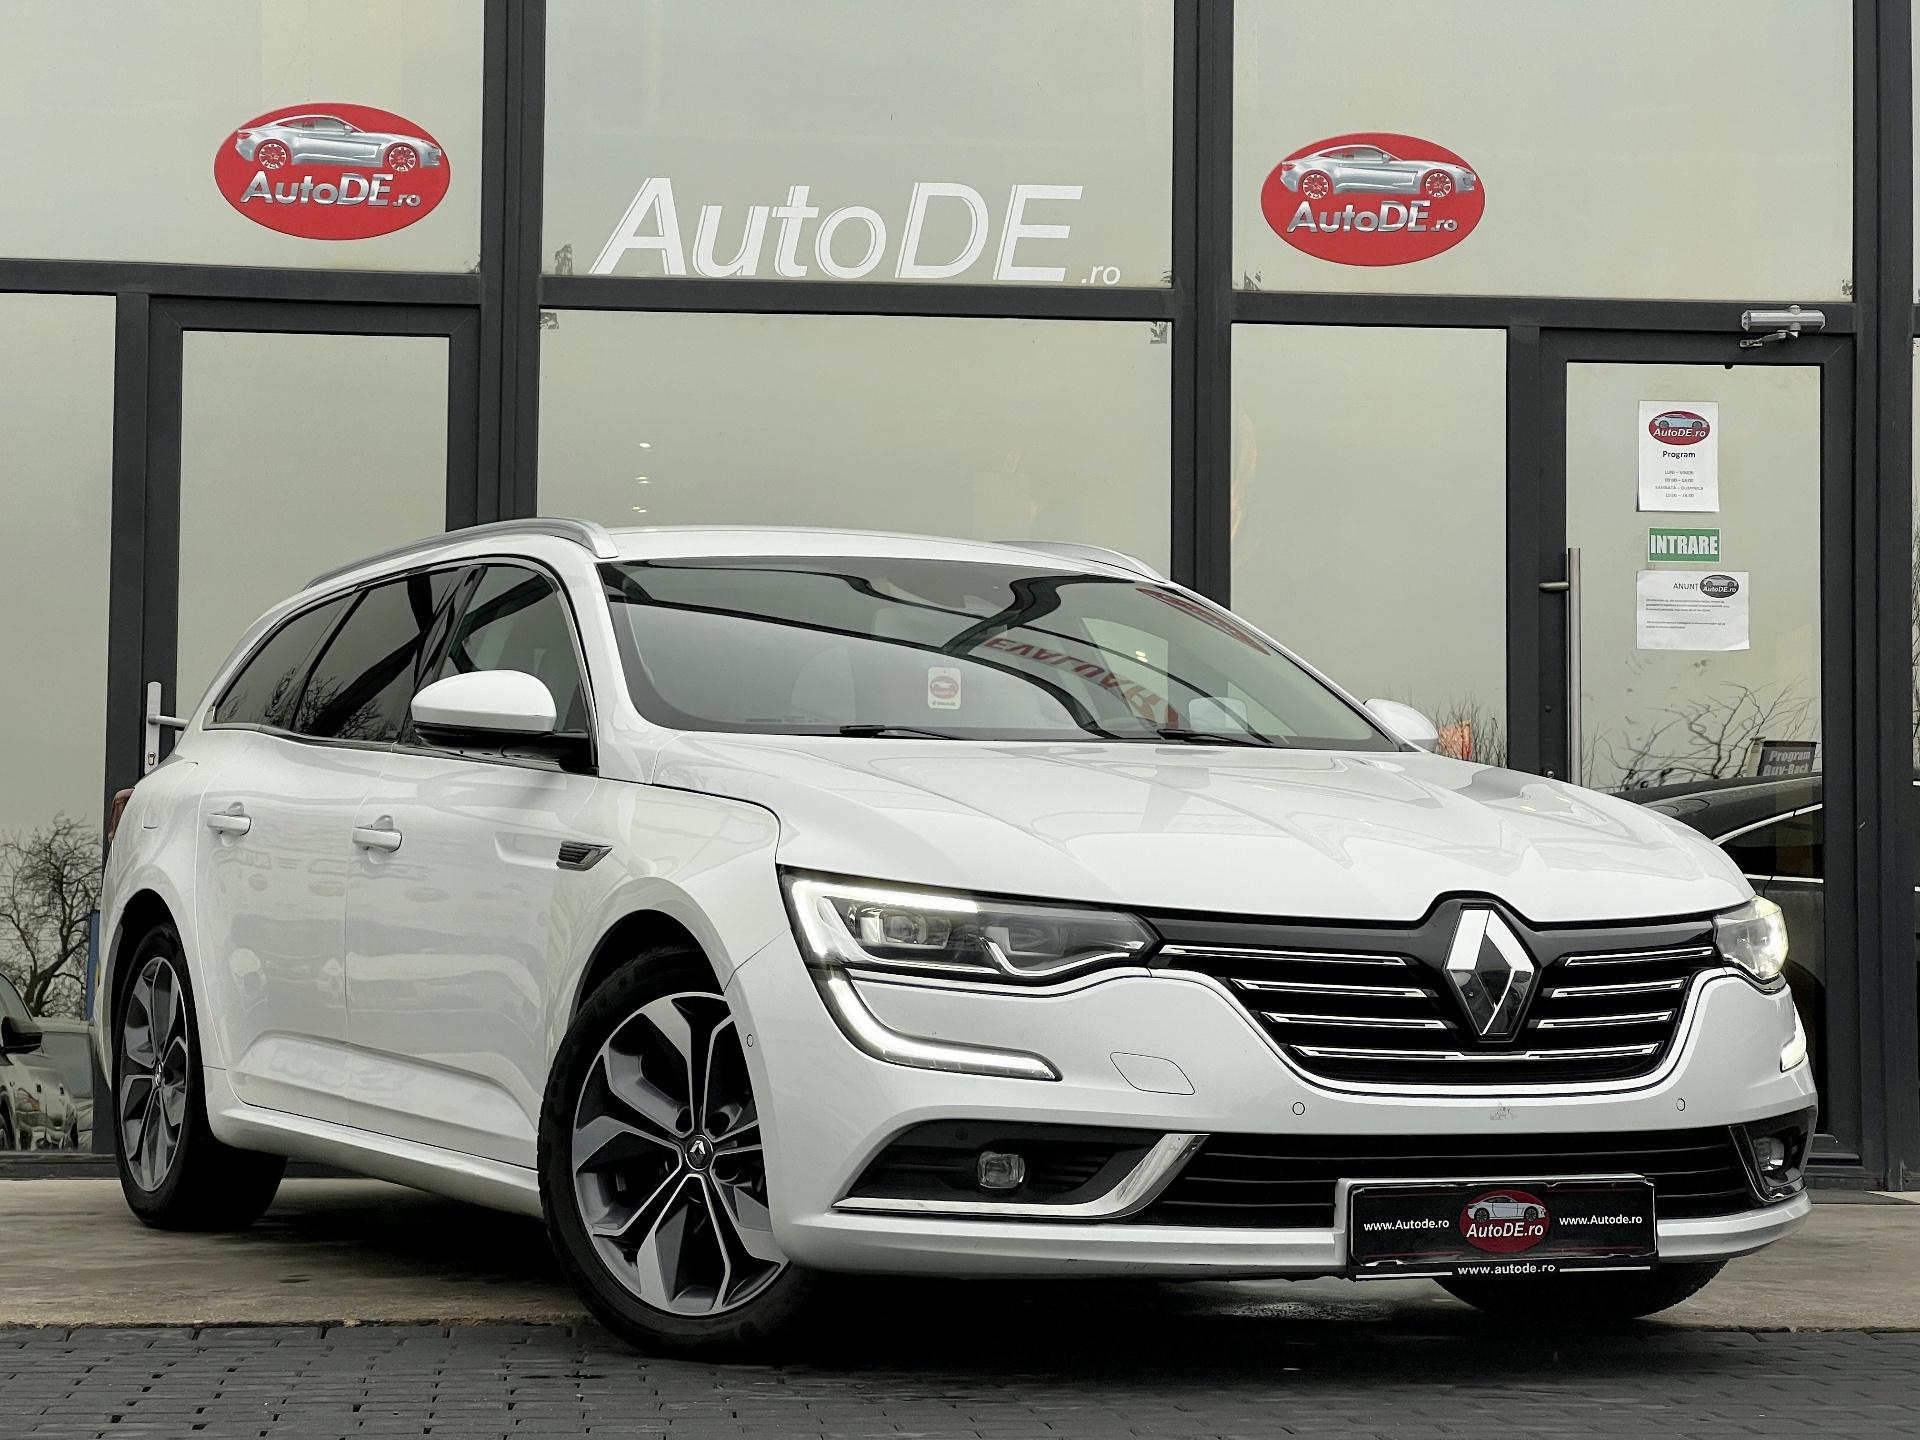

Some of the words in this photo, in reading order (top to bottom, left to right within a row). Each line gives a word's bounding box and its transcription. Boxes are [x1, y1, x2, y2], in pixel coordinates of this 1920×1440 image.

[1653, 427, 1706, 438] AutoDE.ro
[1662, 450, 1696, 460] Program
[1650, 534, 1718, 555] INTRARE
[1769, 750, 1811, 762] Program
[1363, 1218, 1450, 1231] www.Autode.ro
[1559, 1214, 1643, 1226] www.Autode.ro
[1466, 1222, 1544, 1239] AutoDE.ro
[1457, 1263, 1556, 1275] www.autode.ro
